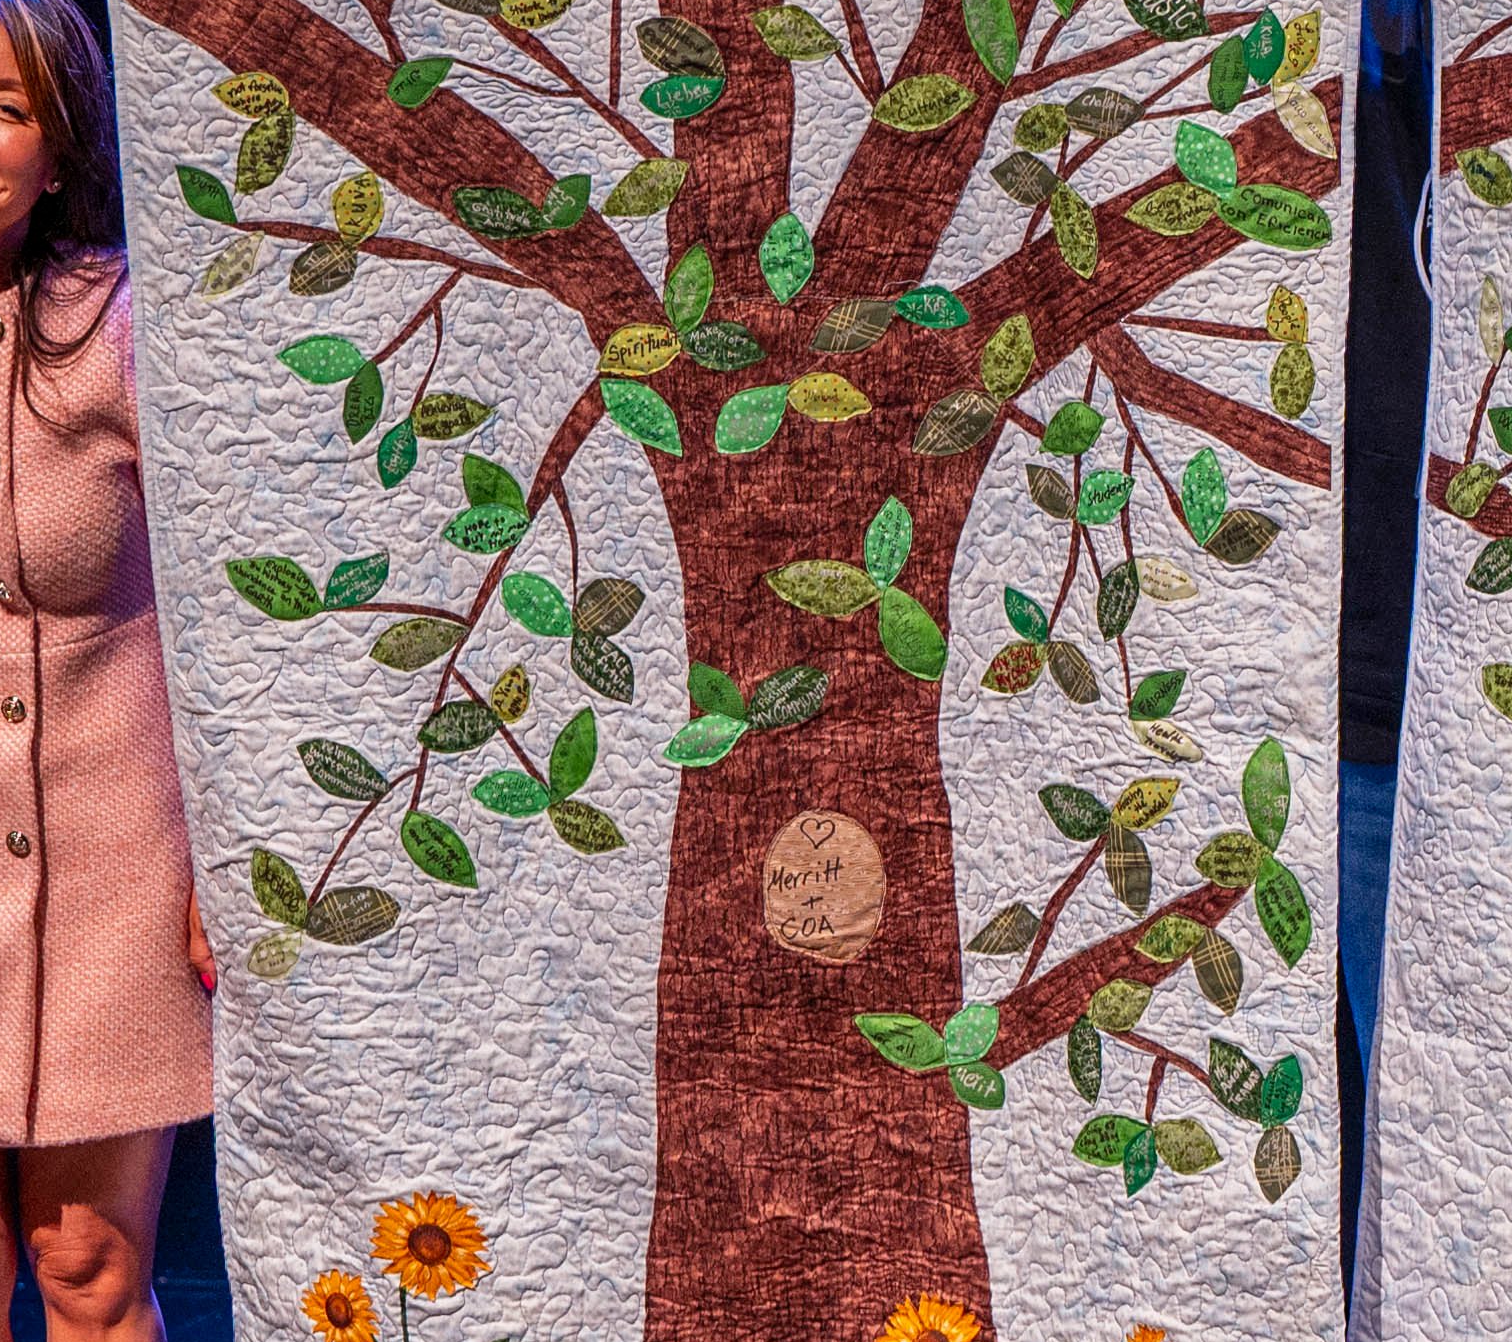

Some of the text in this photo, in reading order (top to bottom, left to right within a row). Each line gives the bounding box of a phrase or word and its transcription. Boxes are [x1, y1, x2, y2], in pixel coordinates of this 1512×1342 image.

[888, 82, 910, 105] All
[898, 91, 961, 120] Cultures
[1241, 188, 1329, 227] Comunicar
[593, 635, 631, 673] PEACE
[1138, 674, 1181, 713] FAIRNESS
[768, 856, 844, 893] Merritt
[801, 896, 824, 910] +
[780, 915, 835, 940] COA
